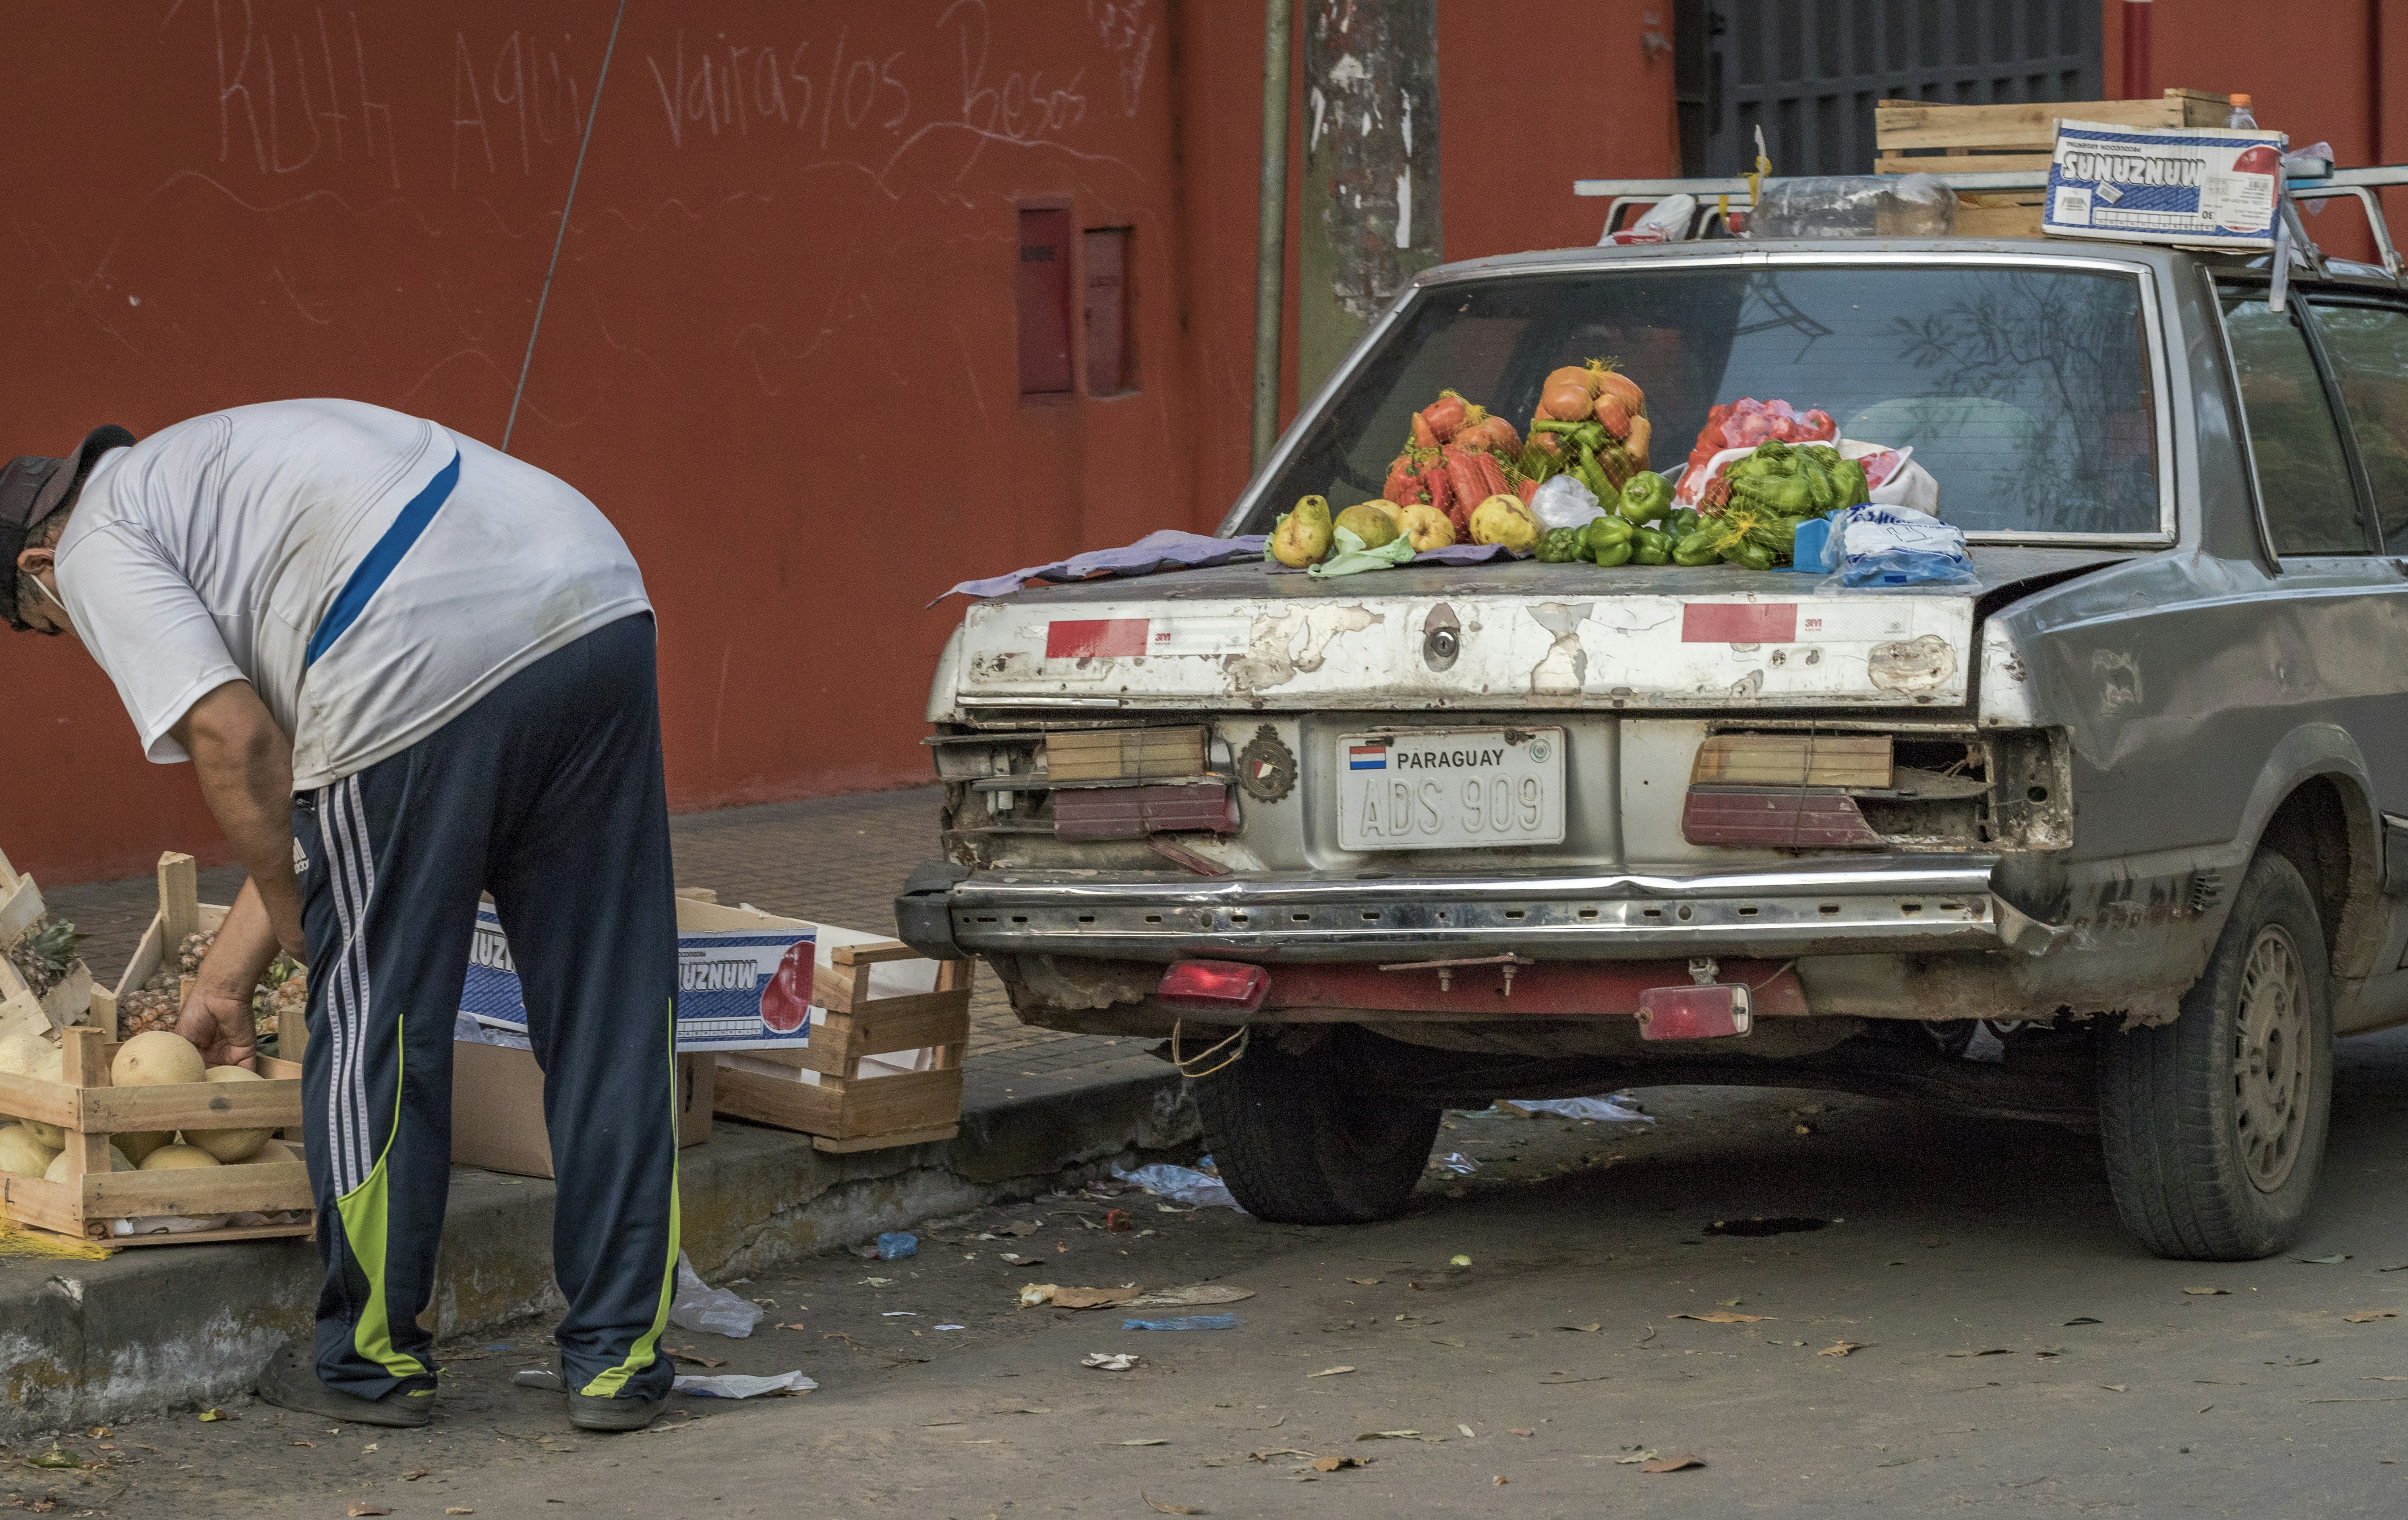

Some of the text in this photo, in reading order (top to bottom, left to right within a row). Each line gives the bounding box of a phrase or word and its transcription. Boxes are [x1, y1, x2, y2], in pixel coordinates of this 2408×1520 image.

[2061, 151, 2205, 188] MANZANAS
[1804, 618, 1822, 627] 3M
[1397, 749, 1505, 769] PARAGUAY
[1360, 771, 1543, 838] ADS 909
[678, 959, 758, 992] MANZA
